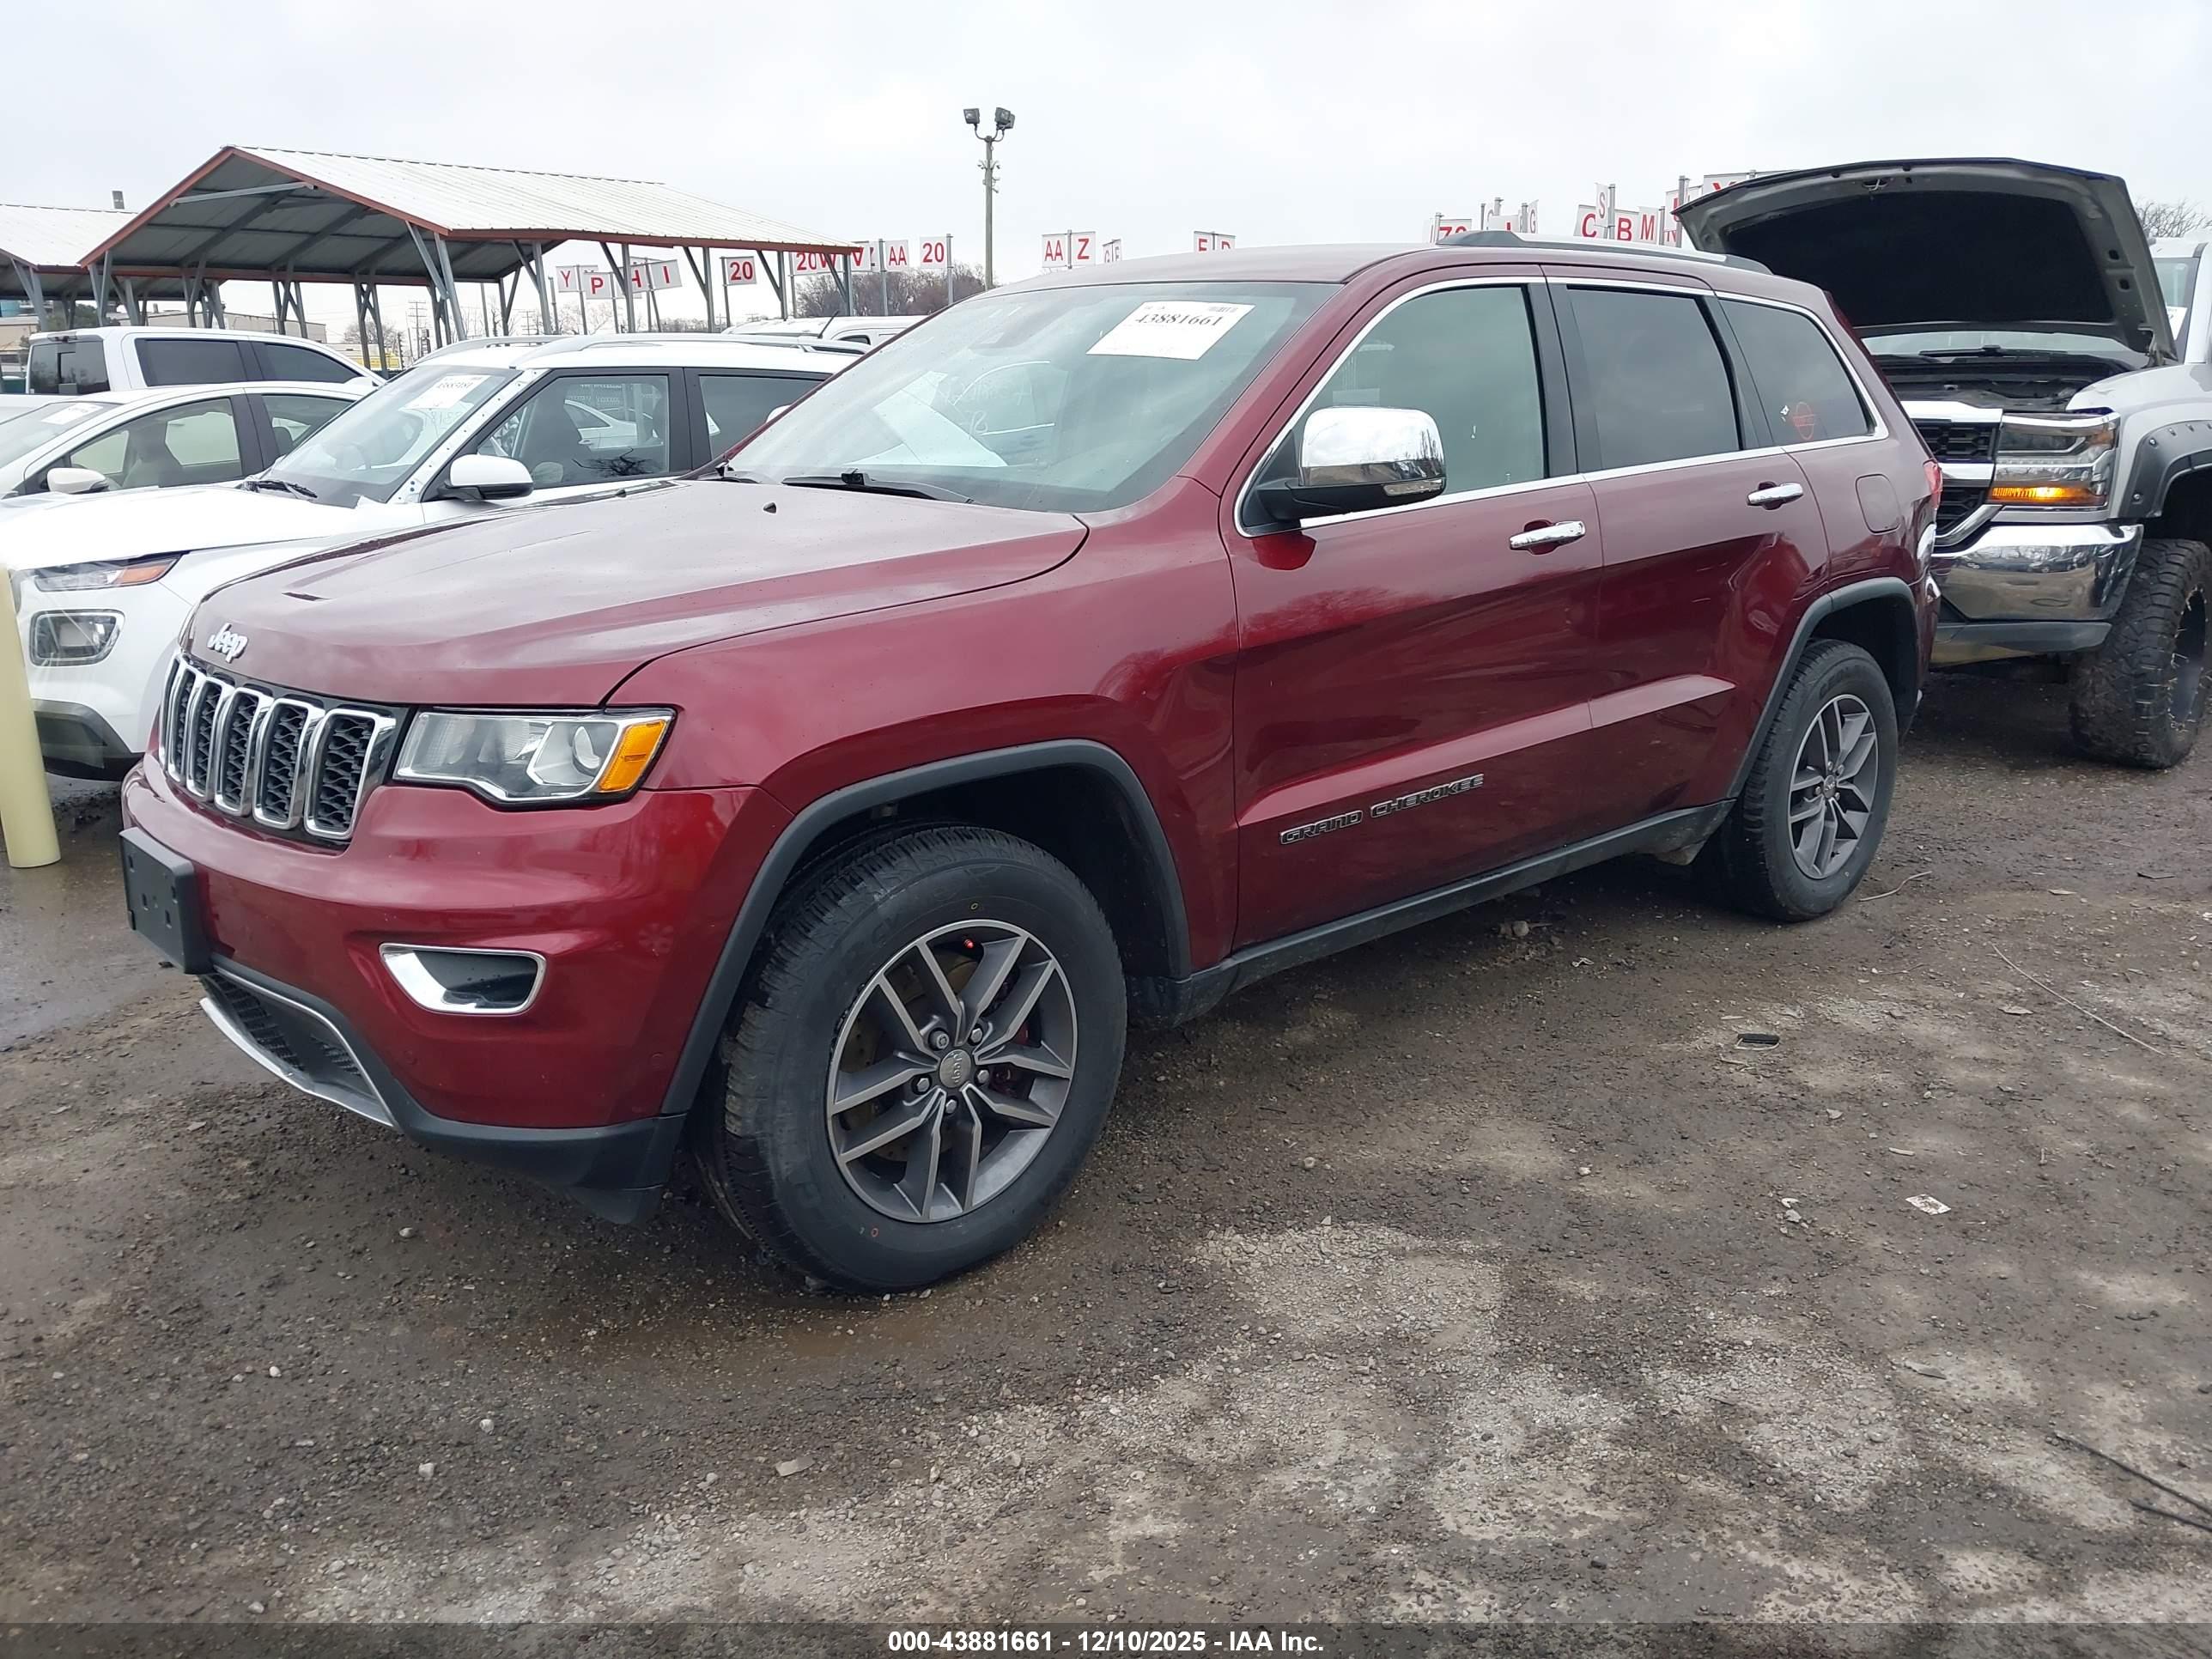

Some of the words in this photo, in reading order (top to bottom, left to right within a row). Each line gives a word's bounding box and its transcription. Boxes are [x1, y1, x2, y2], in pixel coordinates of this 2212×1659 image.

[1598, 191, 1606, 219] S
[1582, 213, 1597, 238] C
[1617, 217, 1632, 241] B
[1640, 214, 1656, 240] M
[888, 246, 908, 266] AA
[922, 242, 945, 263] 20
[1044, 240, 1064, 262] AA
[1078, 238, 1090, 259] Z
[560, 270, 571, 288] Y
[729, 261, 754, 281] 20
[590, 276, 604, 295] P
[1134, 313, 1224, 326] 43881661
[207, 623, 248, 664] Jeep
[1280, 810, 1363, 845] GRAND
[1370, 773, 1485, 817] CHEROKEE
